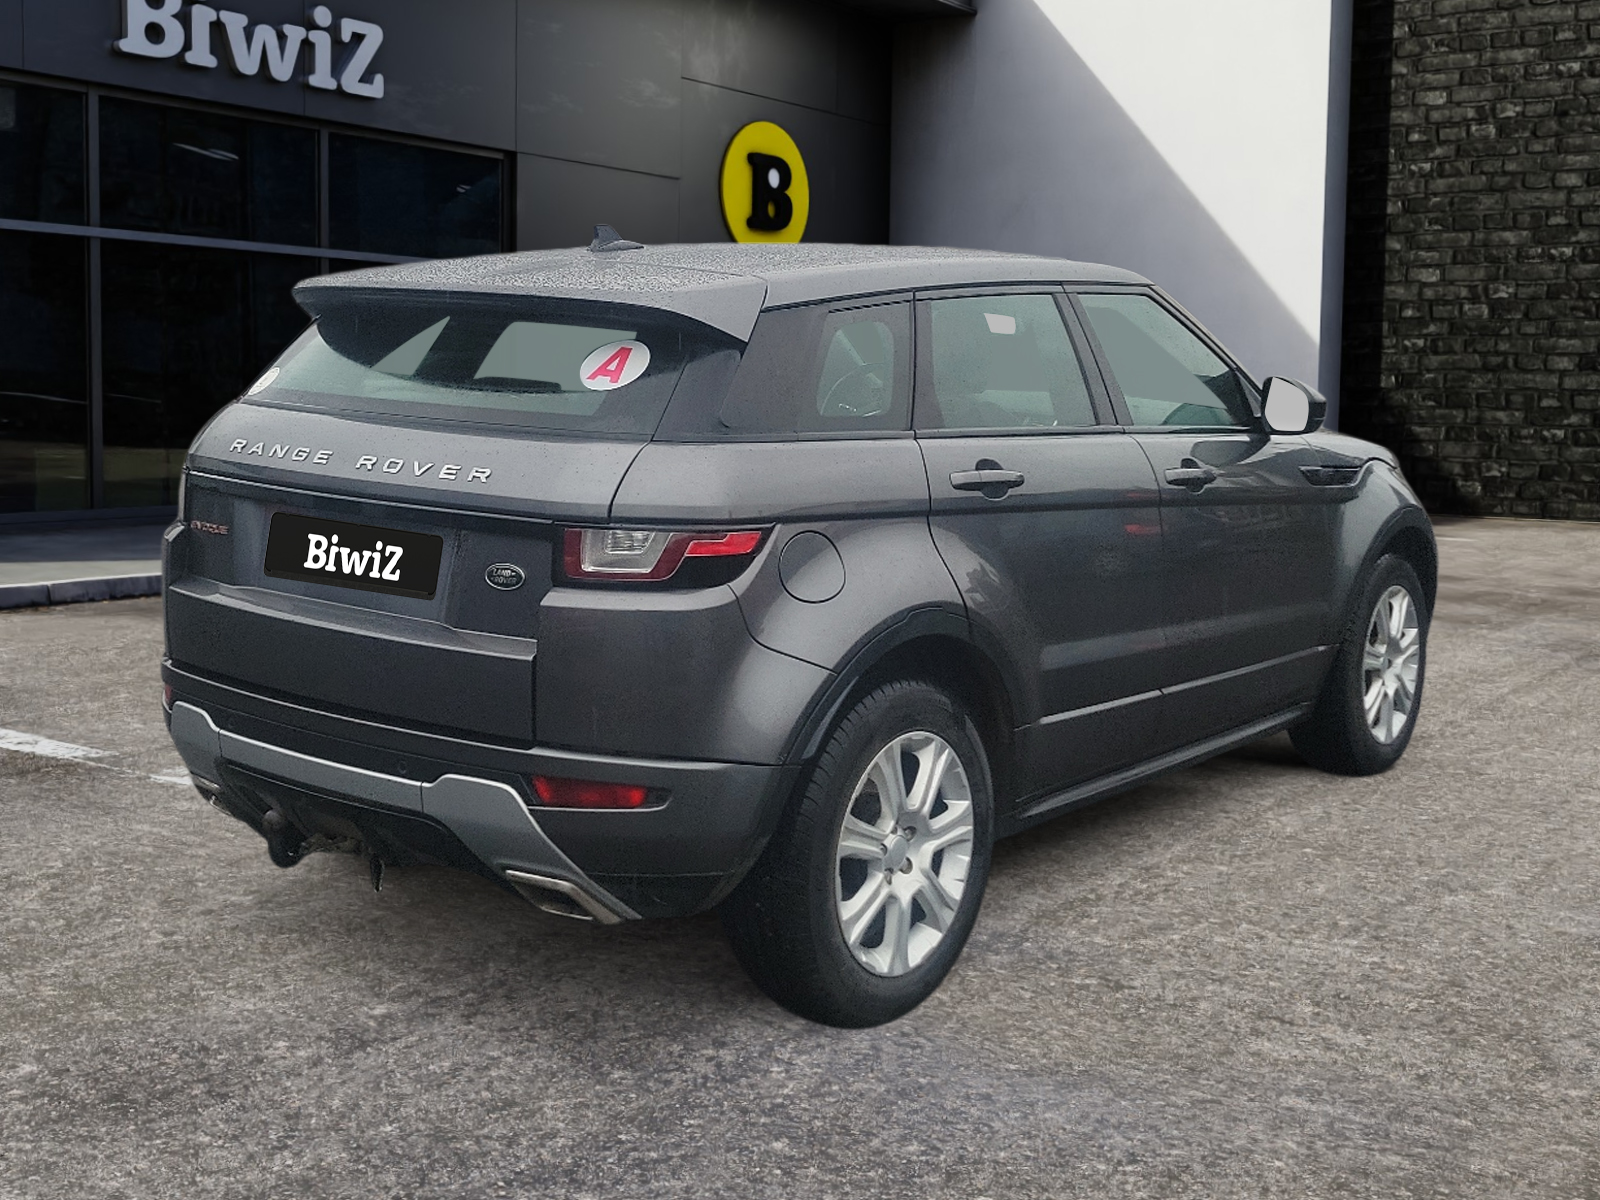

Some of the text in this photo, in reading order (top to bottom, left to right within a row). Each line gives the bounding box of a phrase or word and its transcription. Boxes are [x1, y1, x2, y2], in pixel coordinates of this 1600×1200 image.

[117, 0, 385, 99] BiwiZ
[746, 152, 793, 232] B
[586, 346, 633, 384] A
[229, 438, 492, 483] RANGE ROVER
[303, 533, 404, 582] BiwiZ
